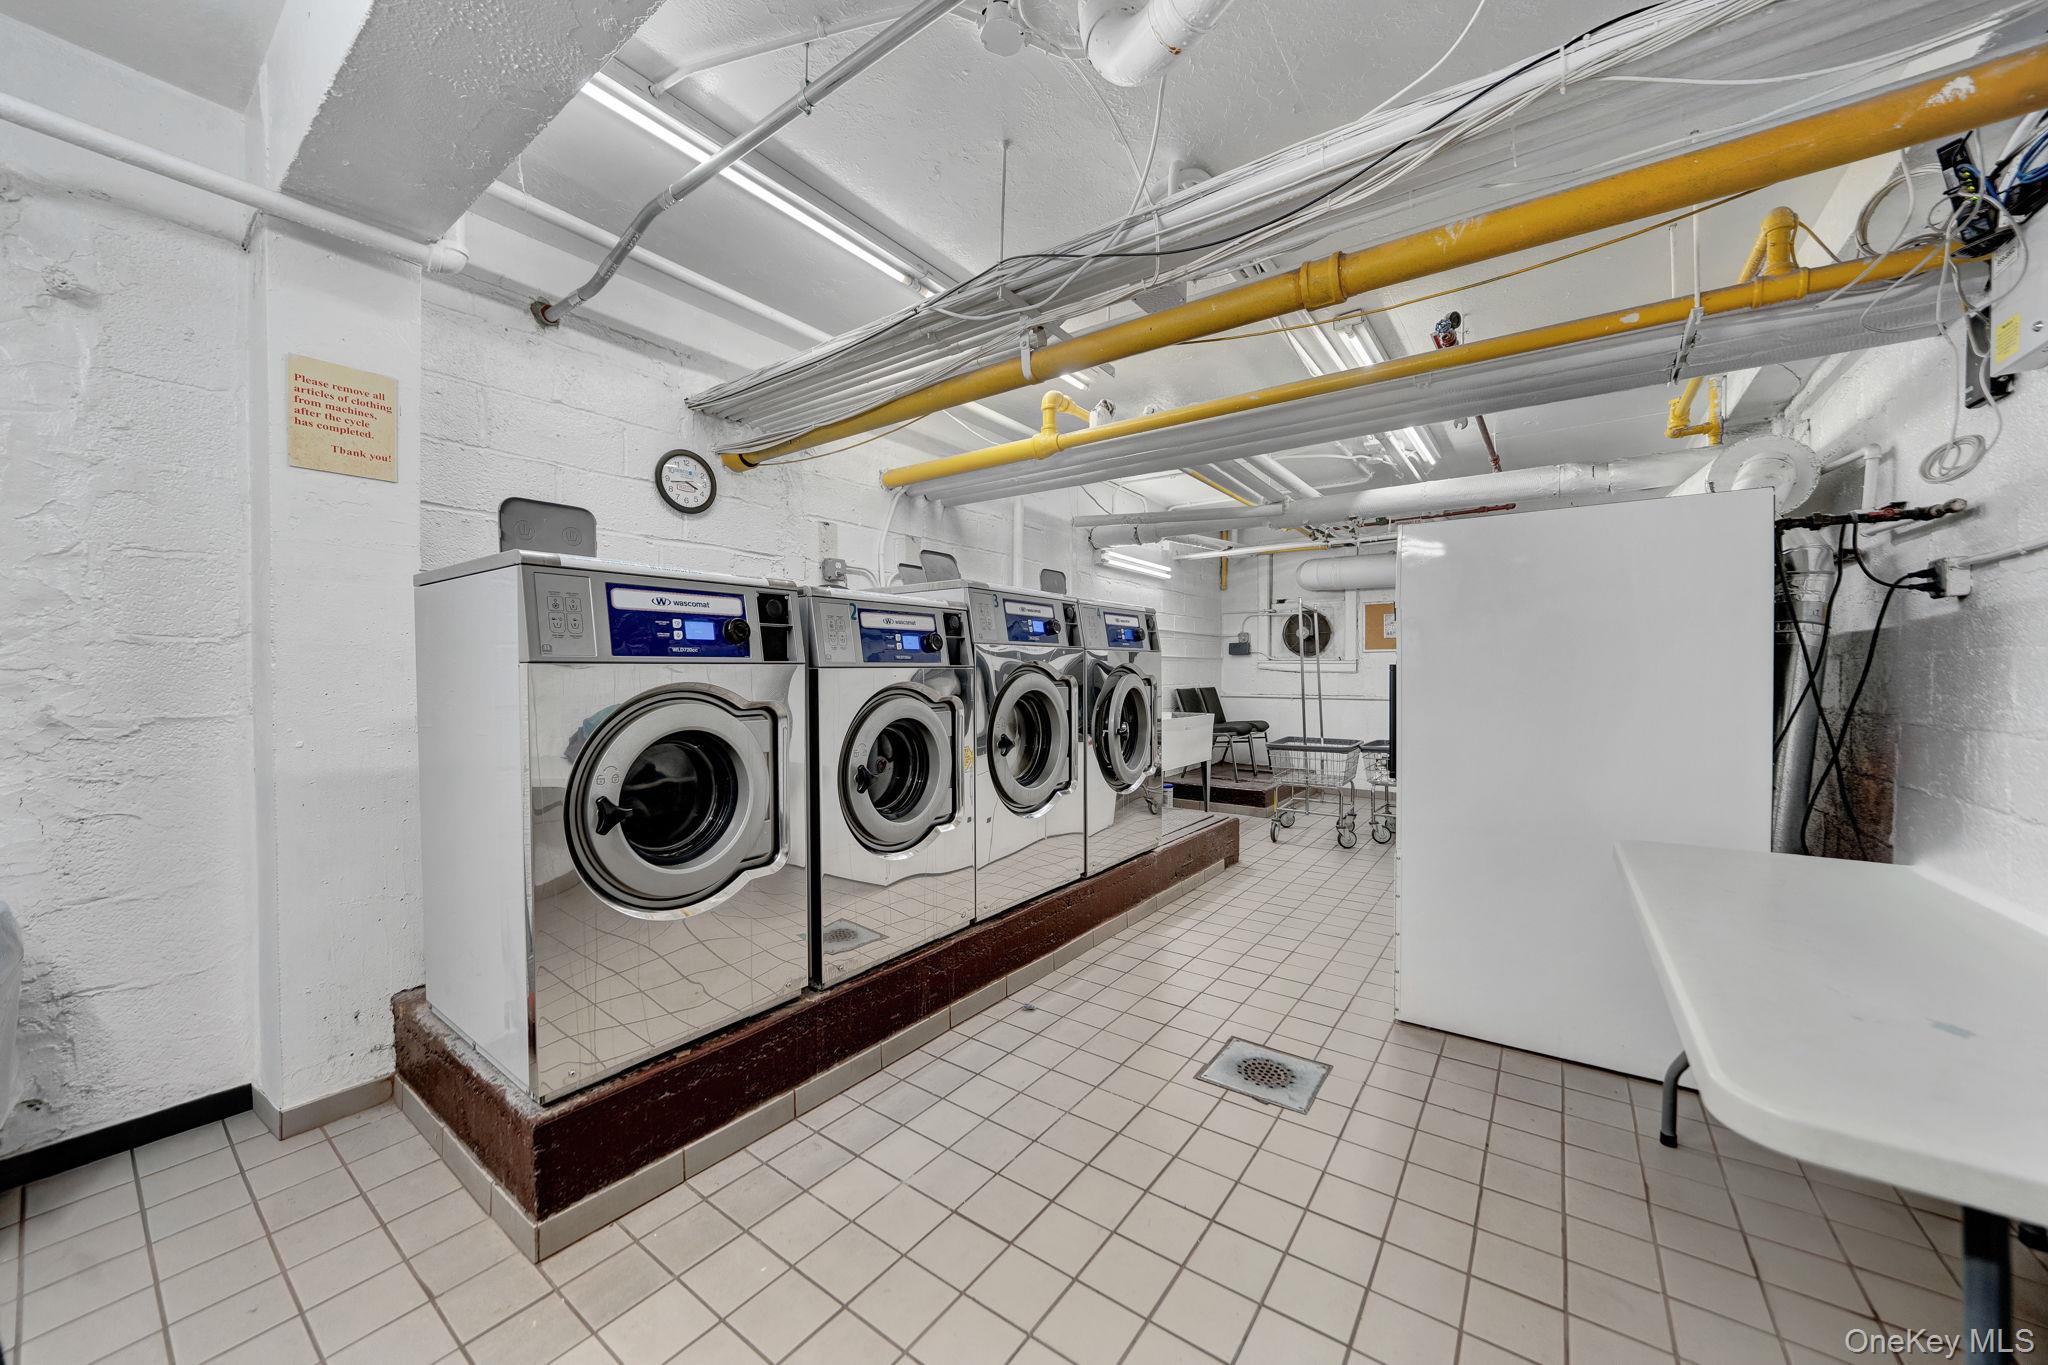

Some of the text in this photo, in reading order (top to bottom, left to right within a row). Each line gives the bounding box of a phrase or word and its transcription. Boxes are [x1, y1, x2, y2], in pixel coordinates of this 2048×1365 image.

[293, 373, 385, 401] Please remove all
[293, 386, 393, 414] articles of clothing
[293, 395, 322, 408] from
[293, 407, 370, 428] after the cycle
[293, 416, 374, 440] has completed.
[330, 444, 392, 463] Thank you!
[673, 599, 711, 609] wascomat
[992, 593, 999, 608] 3
[849, 602, 857, 621] 2
